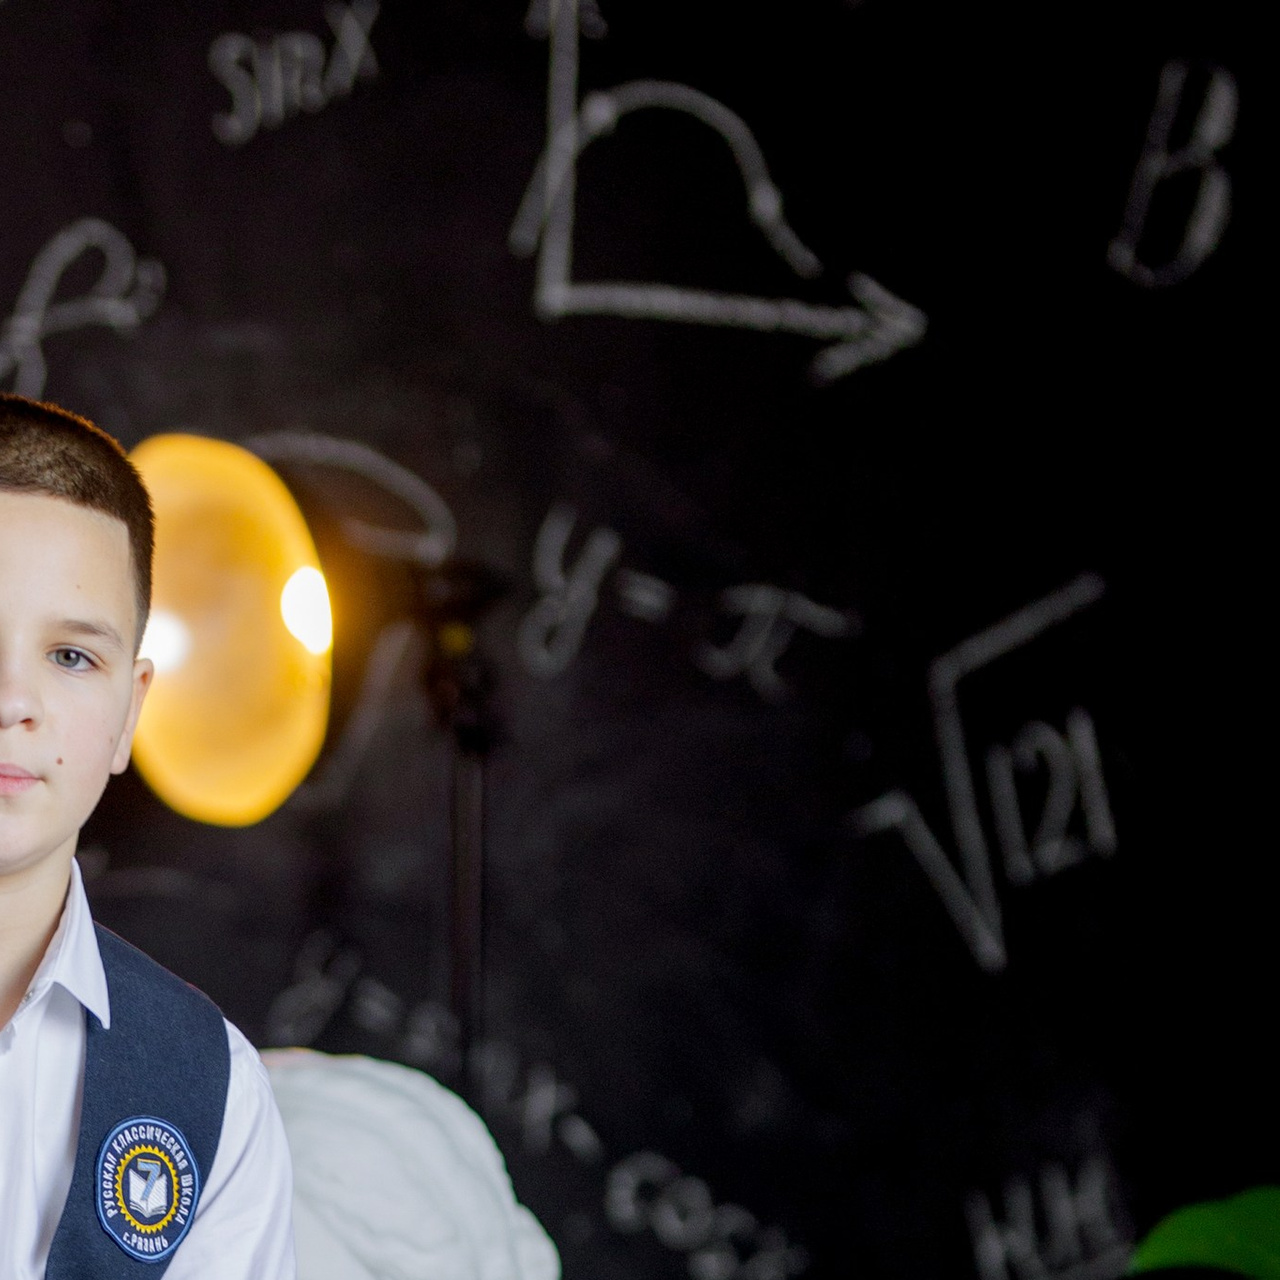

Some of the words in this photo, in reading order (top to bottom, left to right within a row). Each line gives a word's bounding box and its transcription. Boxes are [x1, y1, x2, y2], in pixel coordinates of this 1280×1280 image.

[111, 1124, 189, 1171] КЛАССИЧЕСКАЯ
[174, 1173, 194, 1226] ШКОЛА
[136, 1157, 162, 1202] 7
